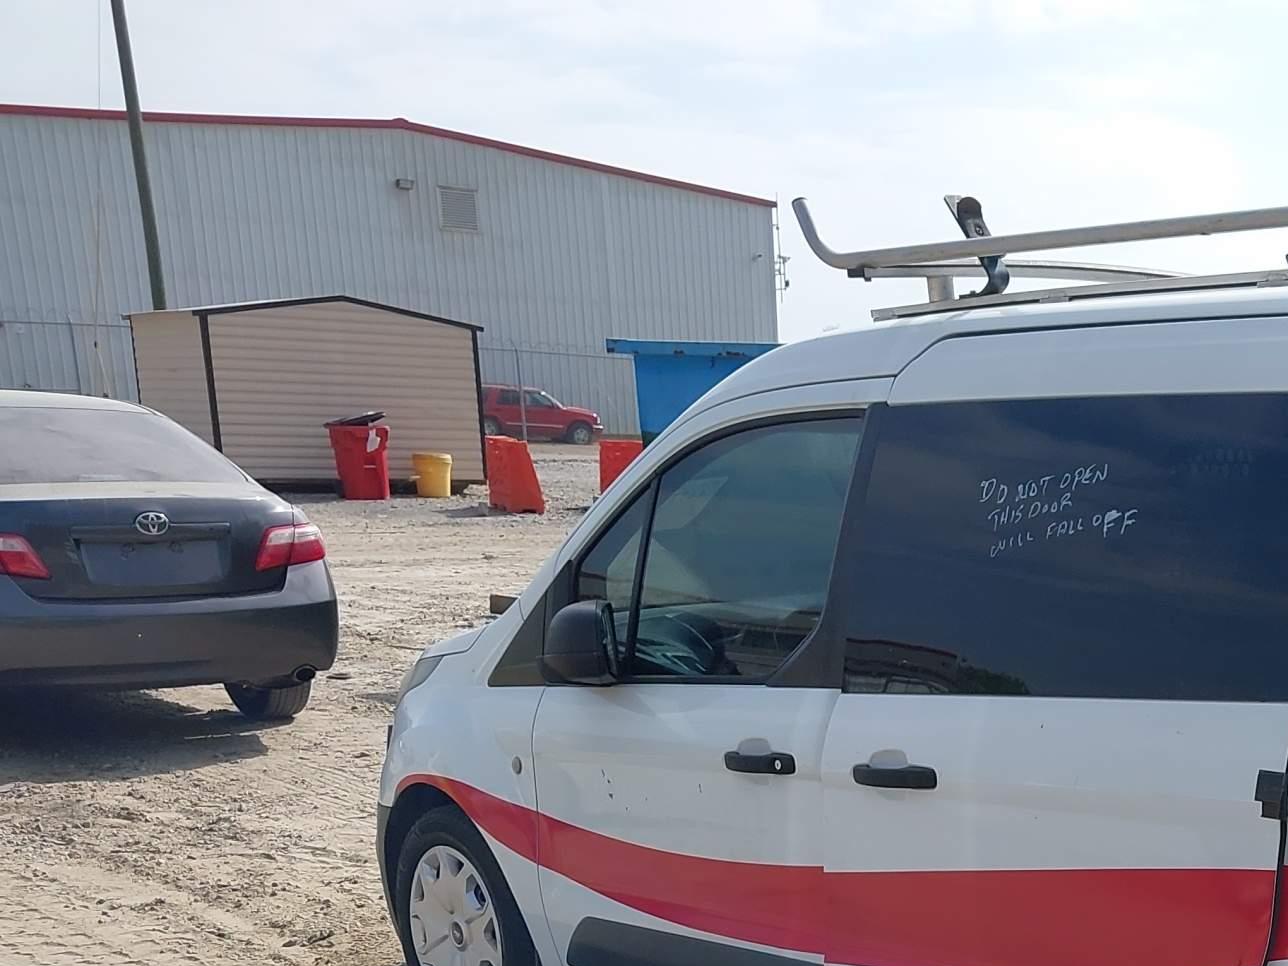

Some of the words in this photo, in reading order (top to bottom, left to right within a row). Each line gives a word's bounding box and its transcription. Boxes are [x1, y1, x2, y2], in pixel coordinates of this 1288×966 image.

[979, 478, 1008, 503] DO
[1015, 475, 1055, 501] NOT
[1060, 463, 1108, 490] OPEN
[987, 504, 1024, 531] THIS
[1028, 492, 1072, 518] DOOR
[1046, 518, 1083, 539] FALL
[1092, 509, 1138, 537] OFF
